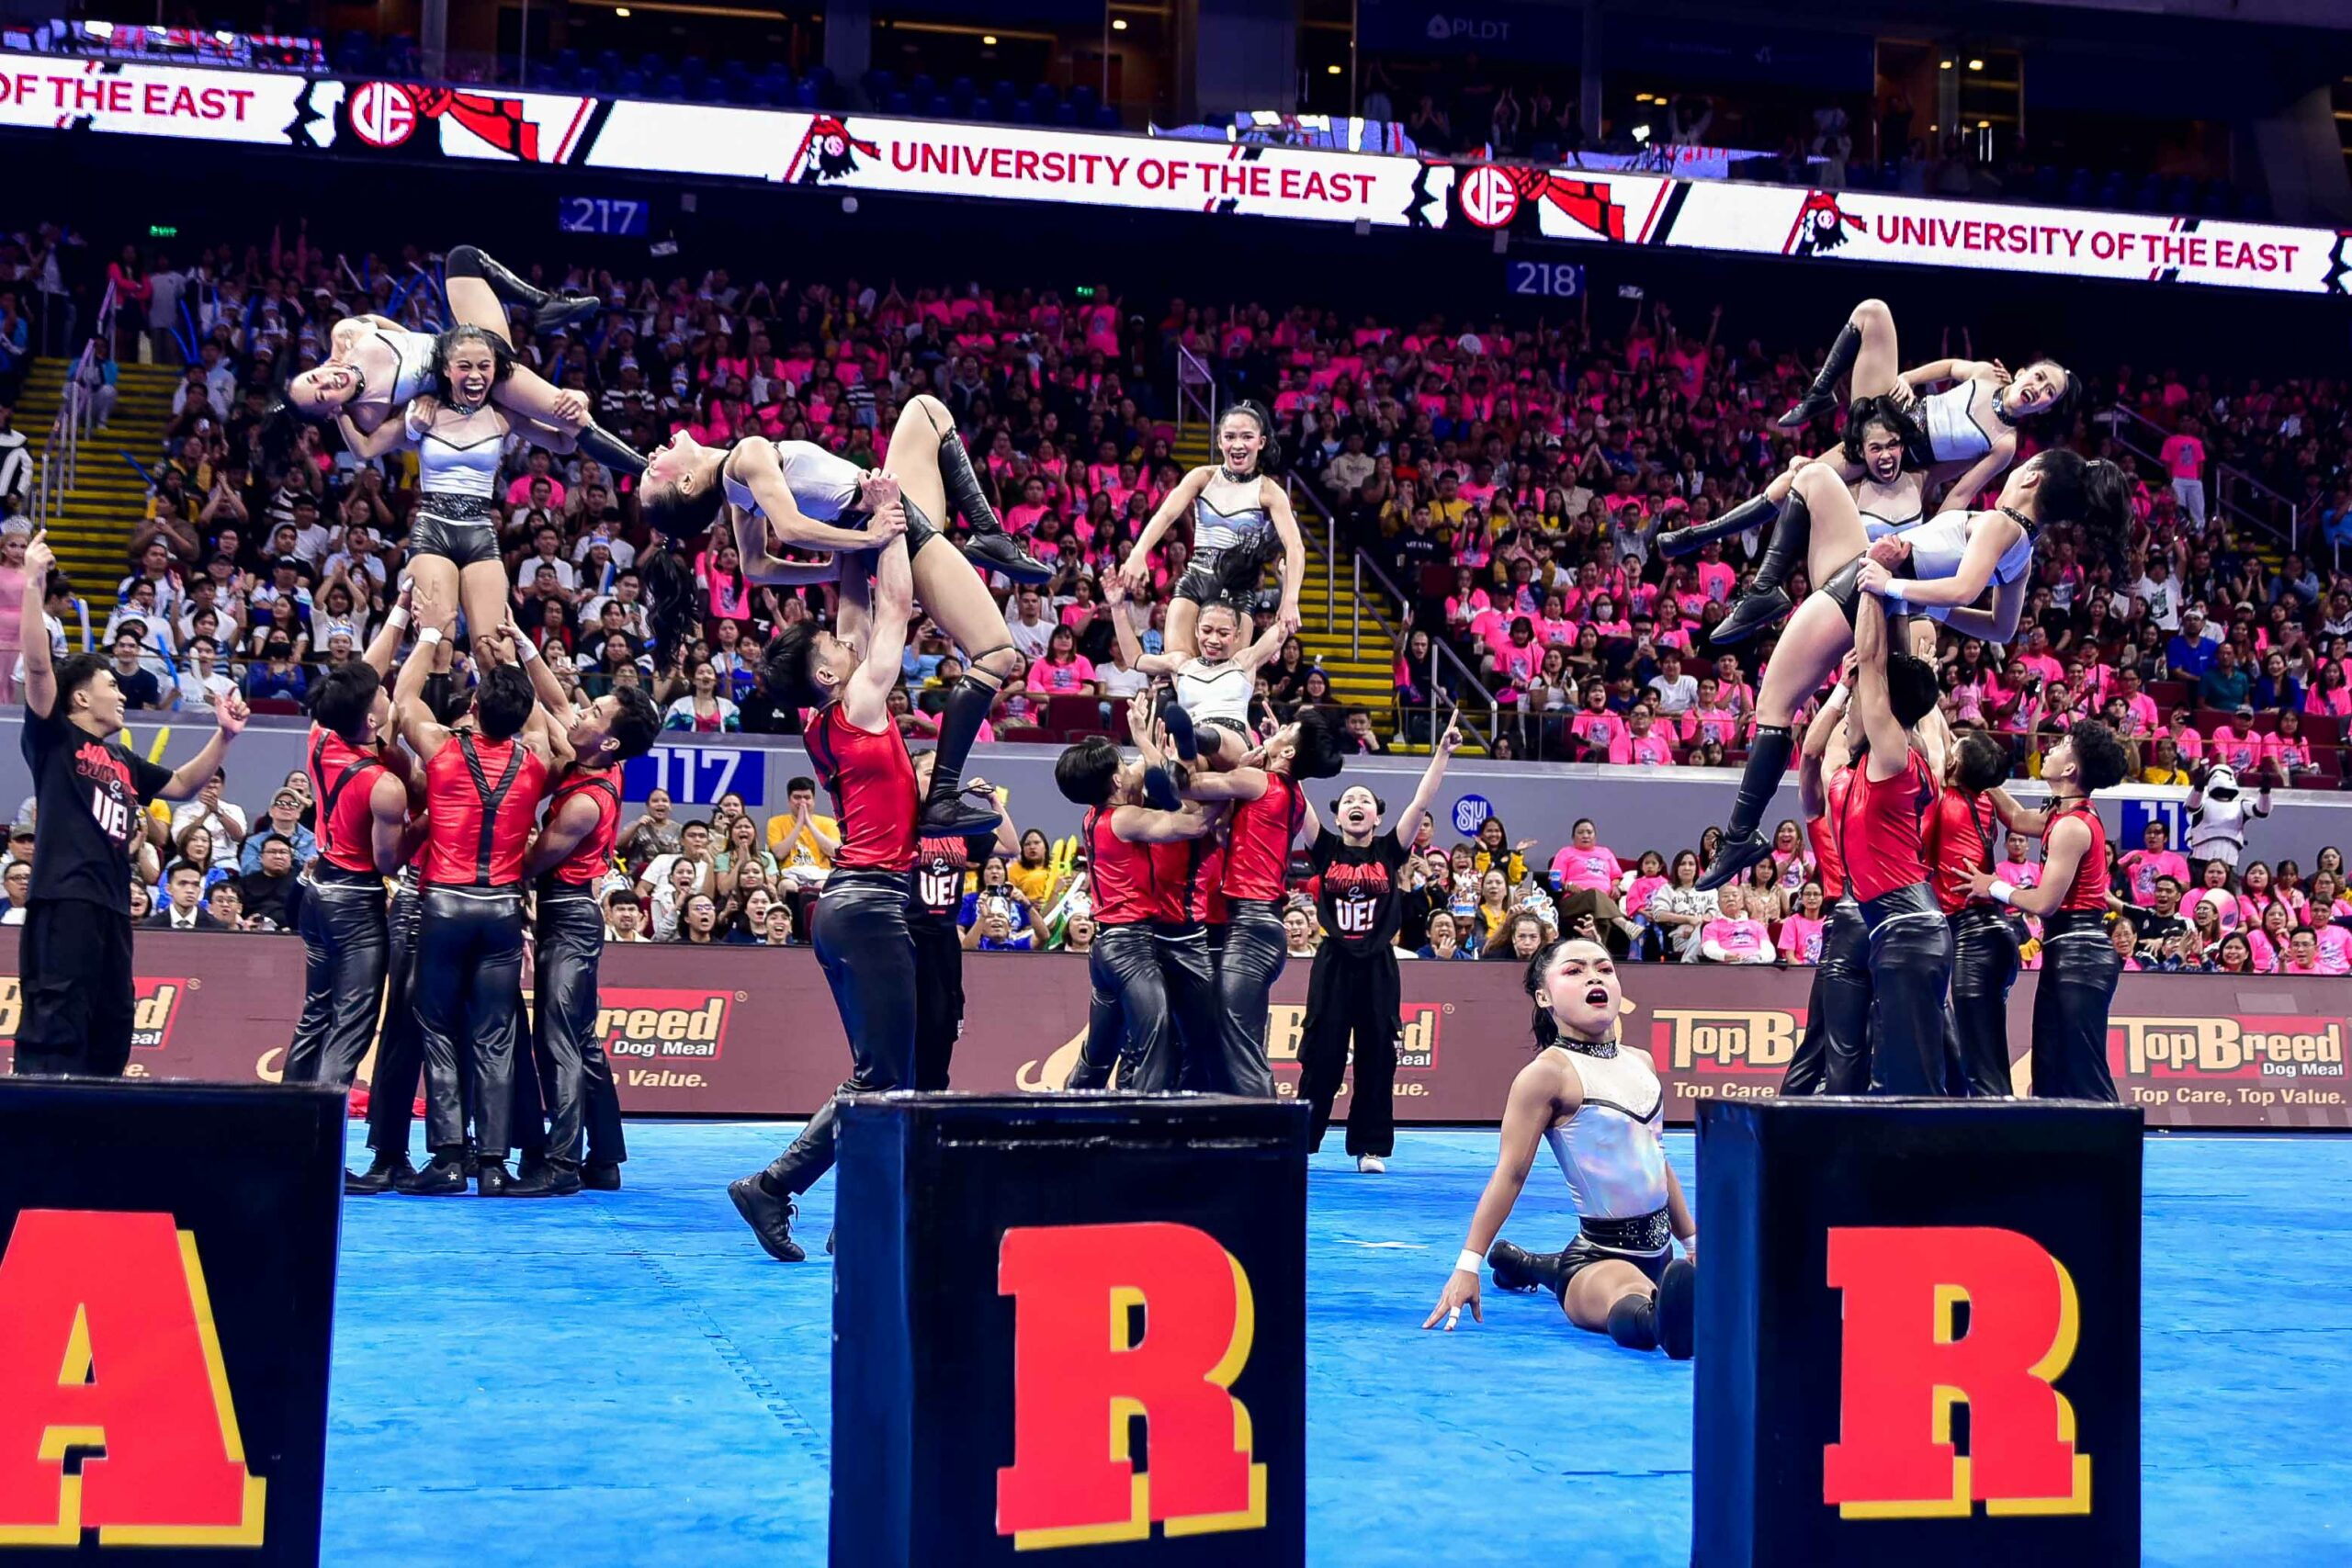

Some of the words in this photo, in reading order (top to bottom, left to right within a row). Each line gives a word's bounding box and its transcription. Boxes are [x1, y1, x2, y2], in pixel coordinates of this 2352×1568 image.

[1452, 17, 1512, 41] PLDT
[47, 75, 132, 113] THE
[143, 84, 255, 121] EAST
[891, 141, 1130, 186] UNIVERSITY
[1136, 159, 1190, 190] OF
[1196, 163, 1271, 197] THE
[1281, 169, 1377, 204] EAST
[572, 197, 639, 234] 217
[1876, 214, 2084, 258] UNIVERSITY
[2091, 231, 2135, 260] OF
[2142, 234, 2208, 266] THE
[2215, 240, 2300, 273] EAST
[1516, 262, 1577, 297] 218
[647, 747, 741, 804] 117
[1456, 799, 1487, 831] SM
[920, 870, 959, 906] UE!
[1335, 897, 1377, 931] UE!
[130, 1032, 164, 1045] eal
[613, 1040, 656, 1057] Dog
[662, 1041, 716, 1055] Meal
[2108, 1016, 2342, 1074] TopBreed
[1396, 1053, 1431, 1066] eal
[2262, 1062, 2297, 1077] Dog
[2301, 1063, 2343, 1076] Meal
[628, 1069, 708, 1088] Value.
[1673, 1081, 1714, 1099] Top
[2131, 1086, 2169, 1104] Top
[2176, 1087, 2233, 1106] Care,
[2237, 1088, 2276, 1105] Top
[2280, 1088, 2346, 1105] Value.
[0, 1209, 266, 1547] A
[996, 1222, 1268, 1551] R
[1823, 1226, 2091, 1519] R
